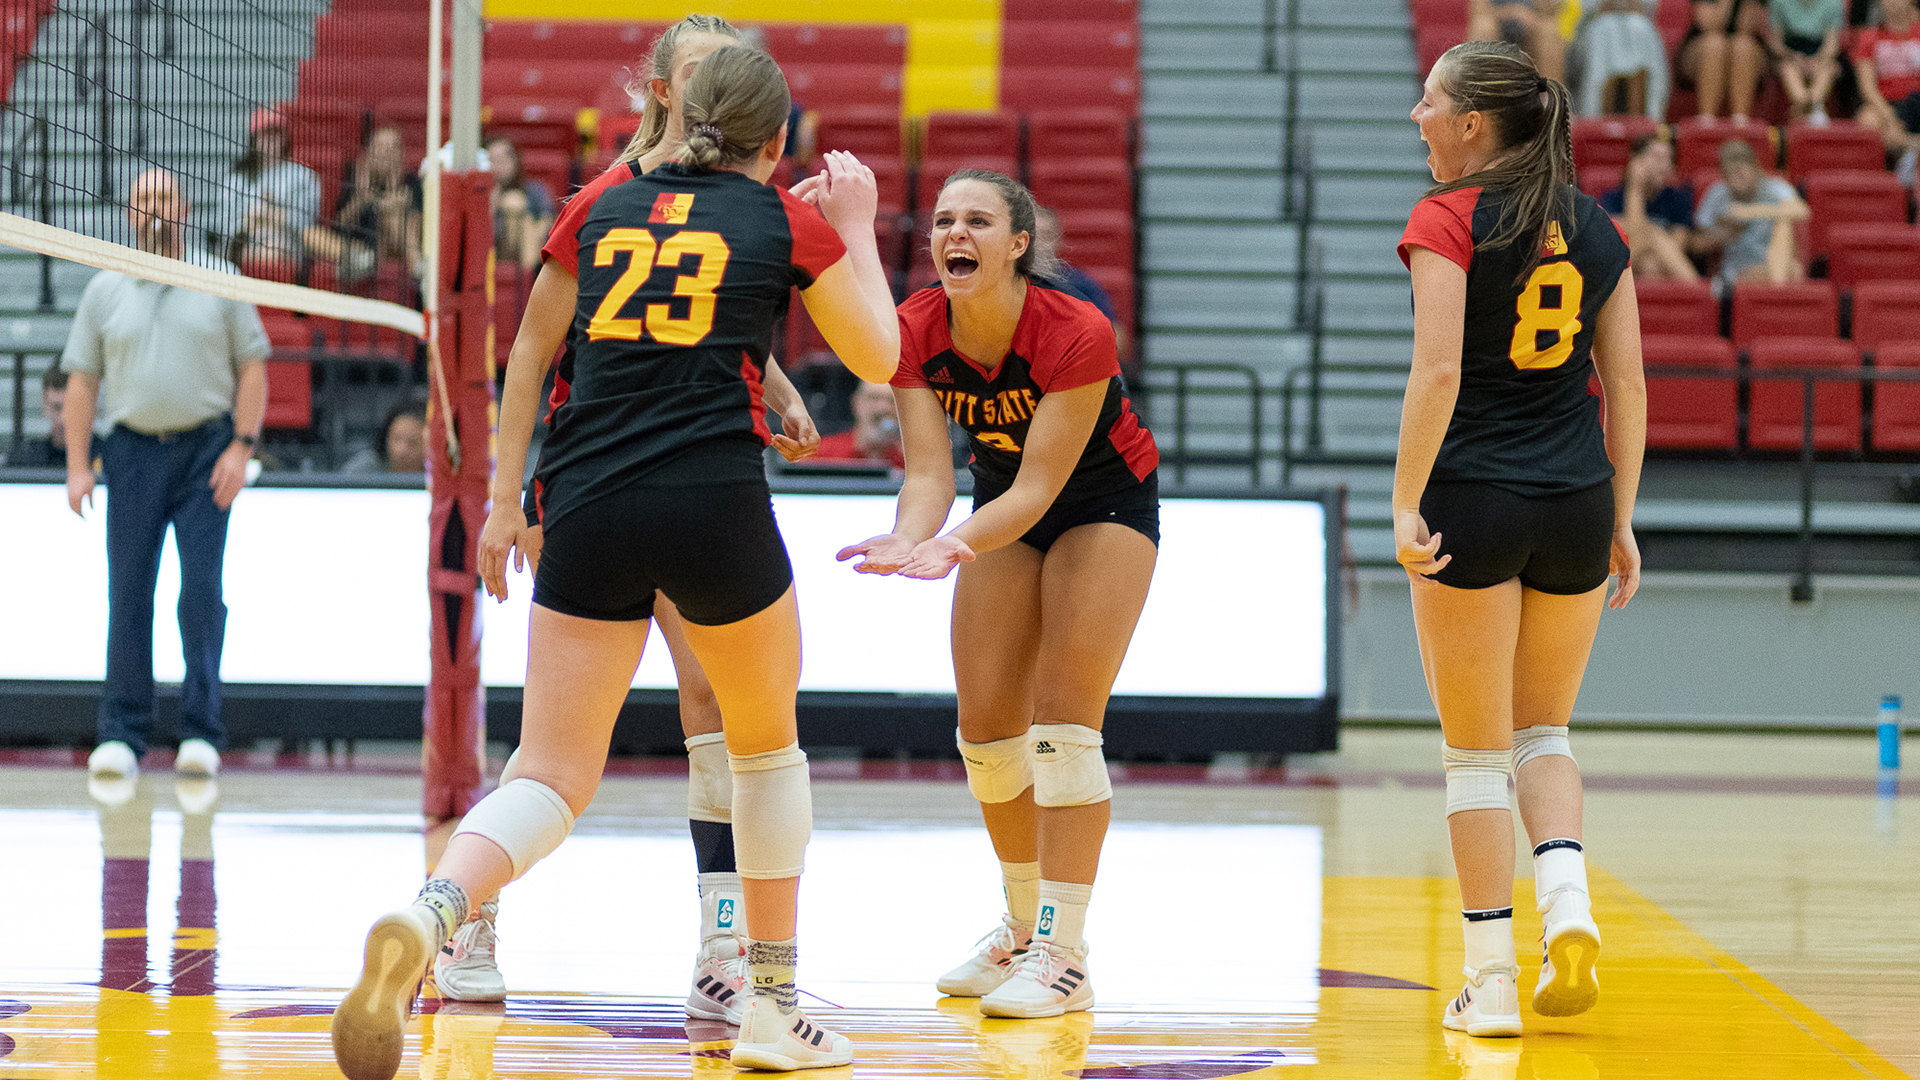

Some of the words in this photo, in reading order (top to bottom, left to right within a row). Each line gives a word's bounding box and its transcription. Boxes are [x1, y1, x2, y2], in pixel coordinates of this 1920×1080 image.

[586, 227, 732, 347] 23
[1508, 260, 1584, 371] 8
[982, 388, 1037, 426] STATE
